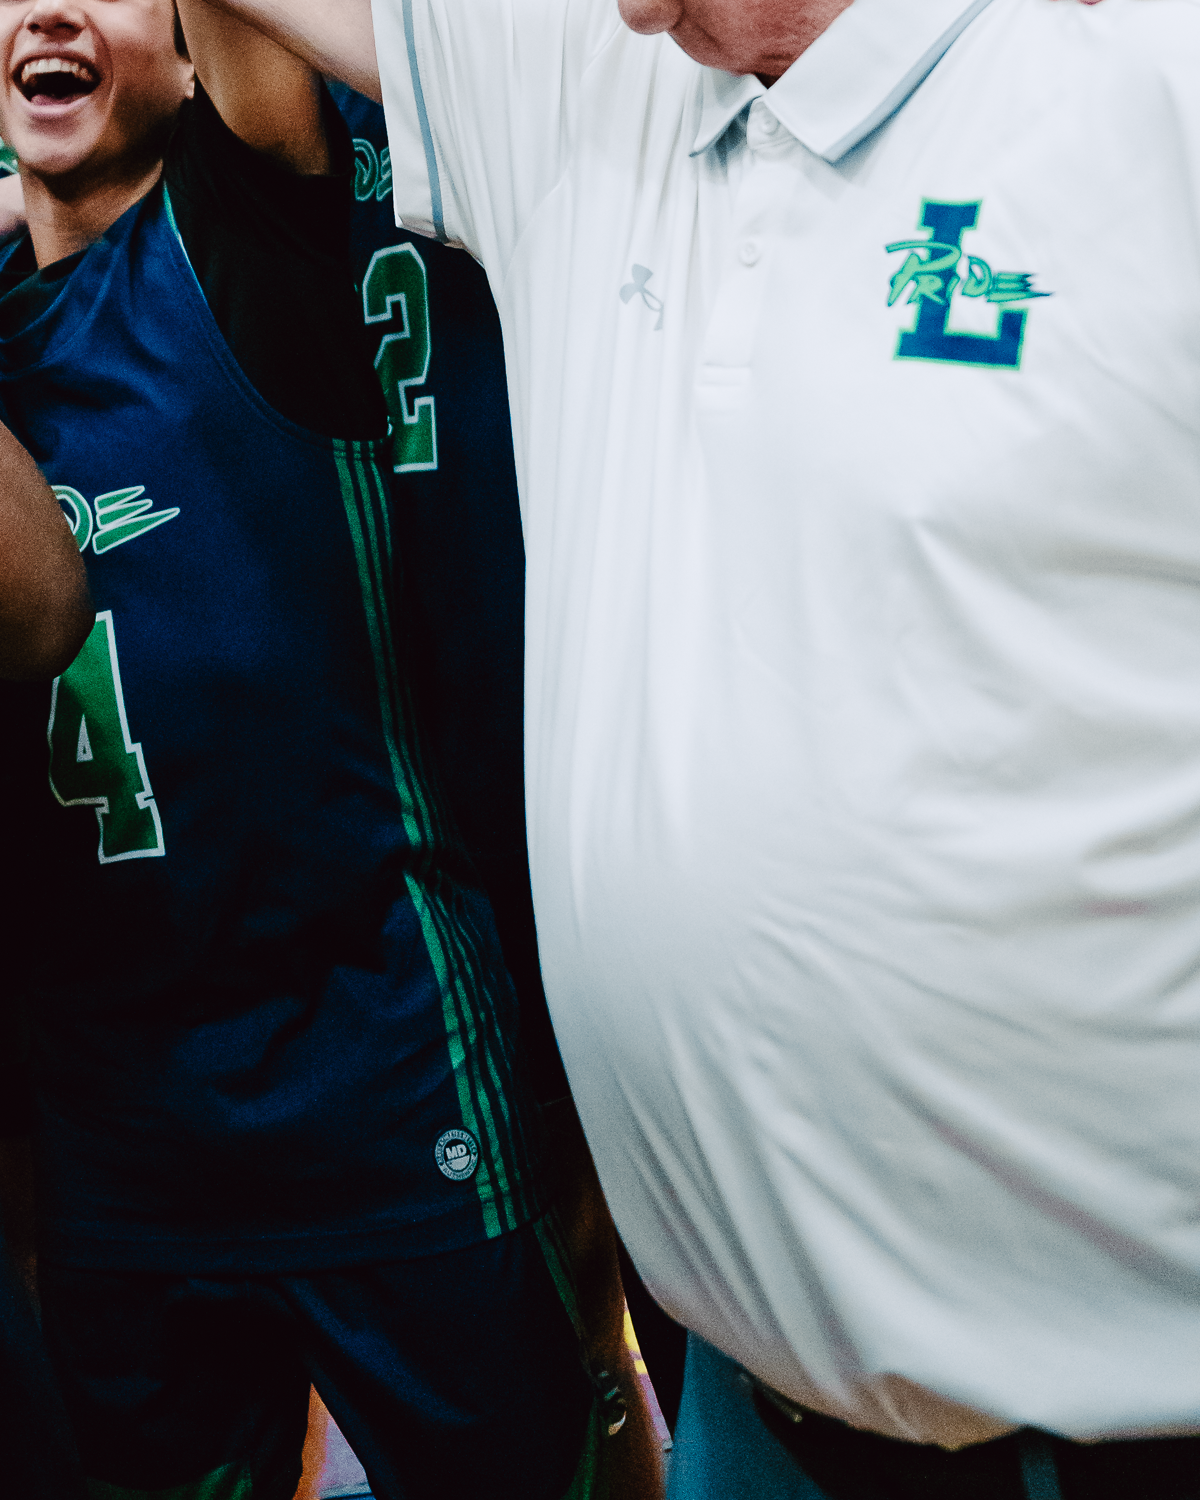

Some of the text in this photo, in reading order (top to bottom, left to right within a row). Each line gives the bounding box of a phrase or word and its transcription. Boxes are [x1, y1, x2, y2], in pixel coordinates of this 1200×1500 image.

[892, 196, 1028, 371] L
[47, 610, 166, 865] 4
[445, 1143, 467, 1160] MD
